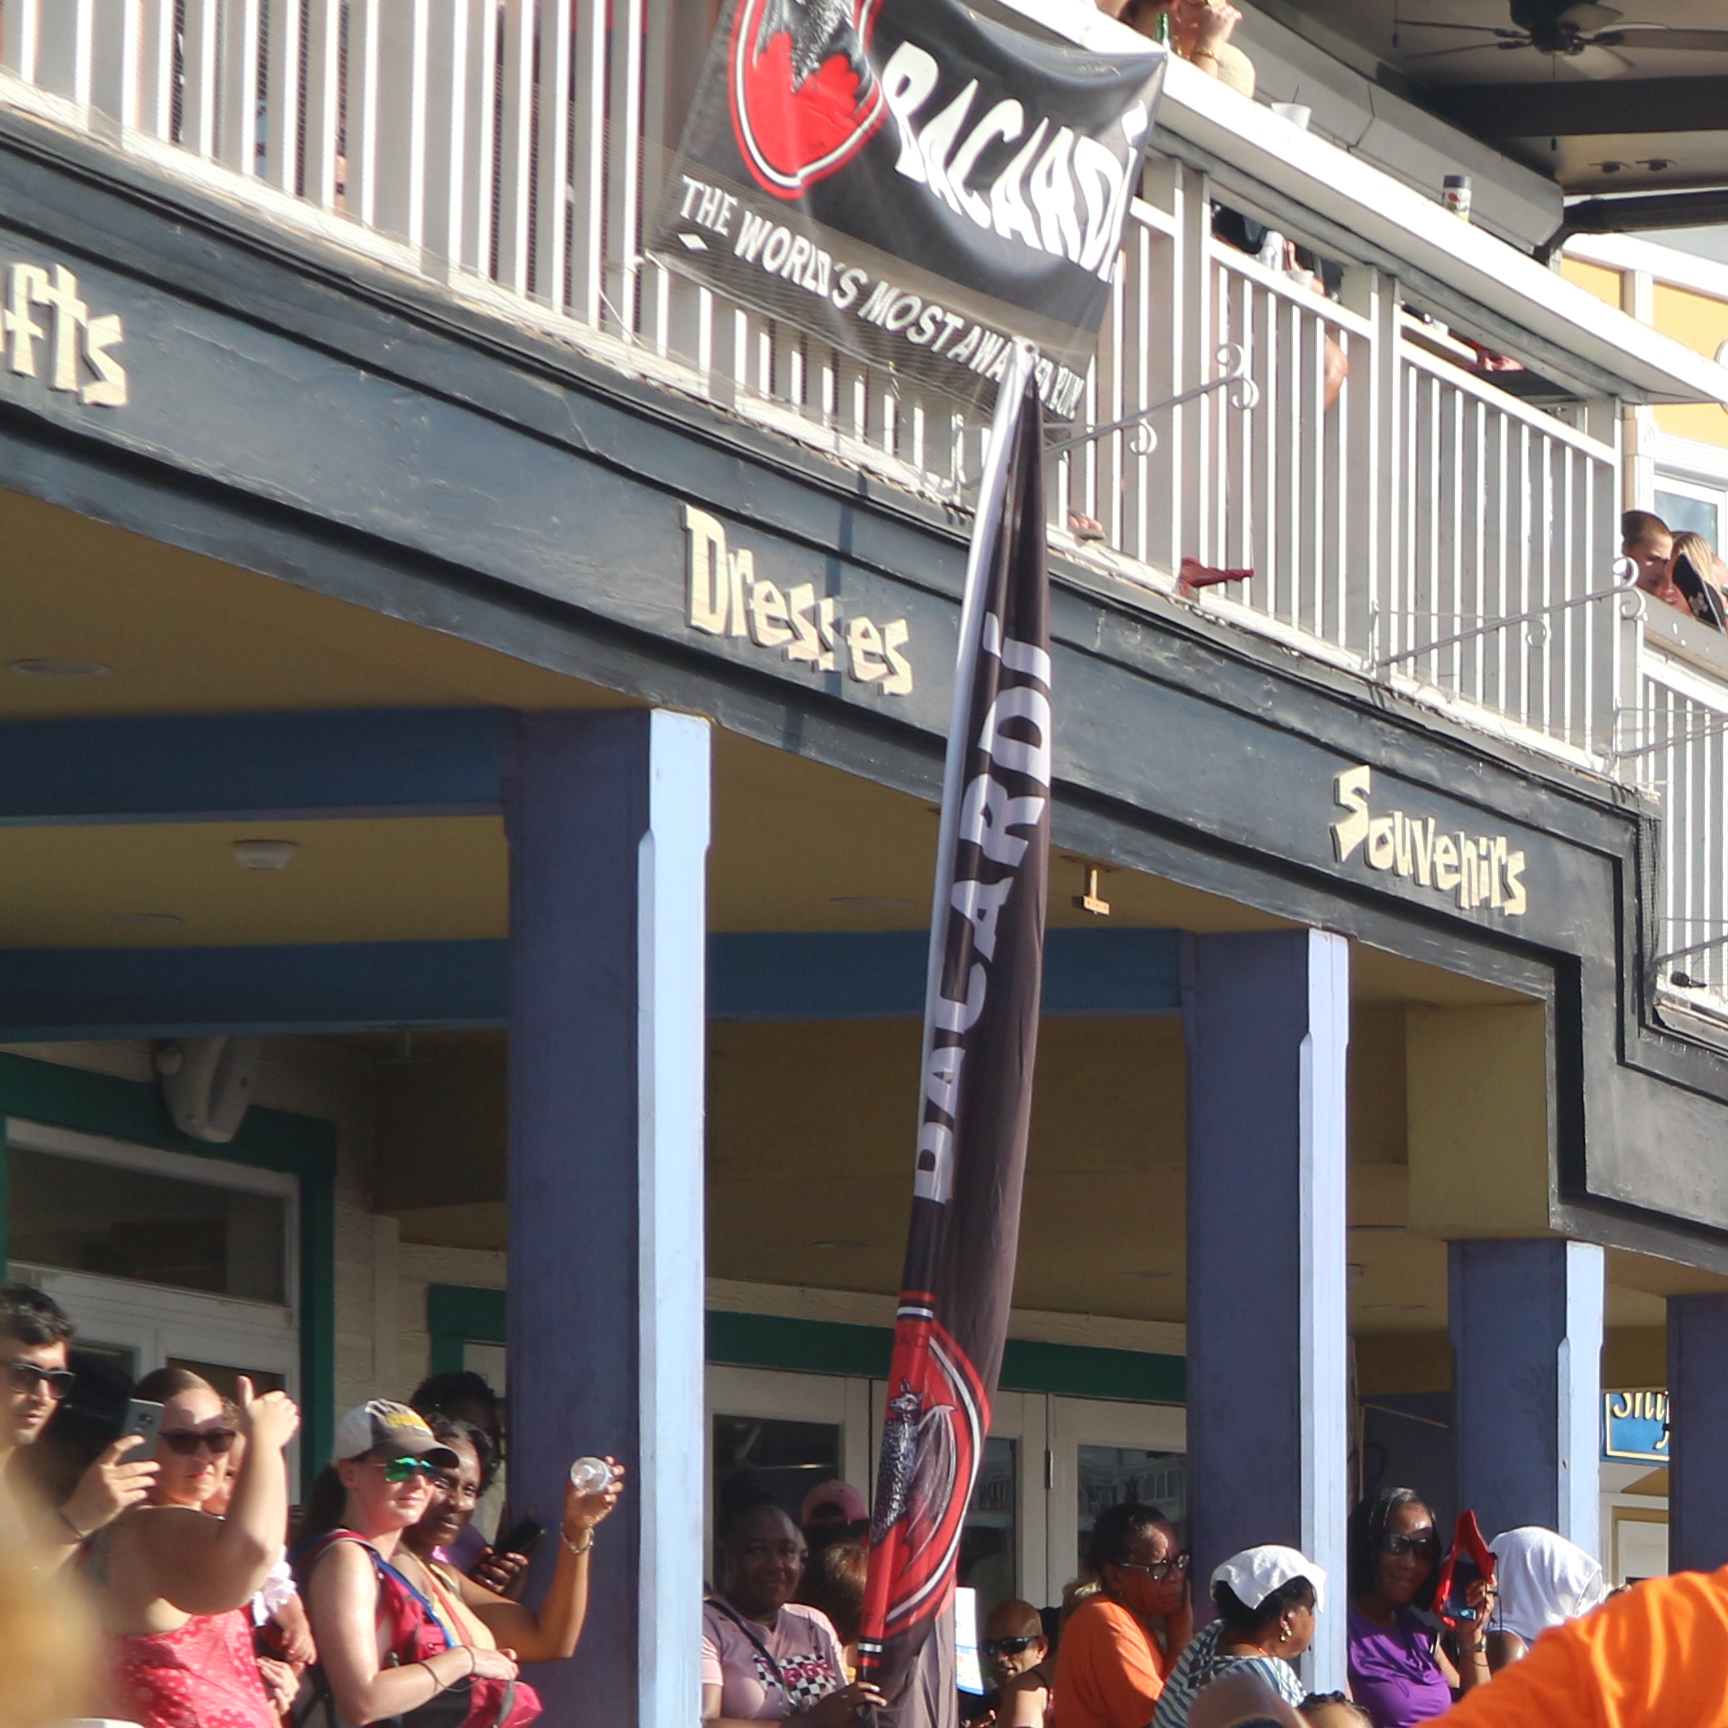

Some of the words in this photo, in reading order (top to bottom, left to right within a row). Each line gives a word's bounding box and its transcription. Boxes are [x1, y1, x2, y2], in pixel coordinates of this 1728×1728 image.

[0, 263, 127, 404] fts
[679, 174, 738, 237] THE
[733, 210, 869, 310] WORLD'S
[857, 280, 965, 353] MOST
[682, 504, 913, 695] Dresses
[1330, 765, 1527, 916] Souvenirs
